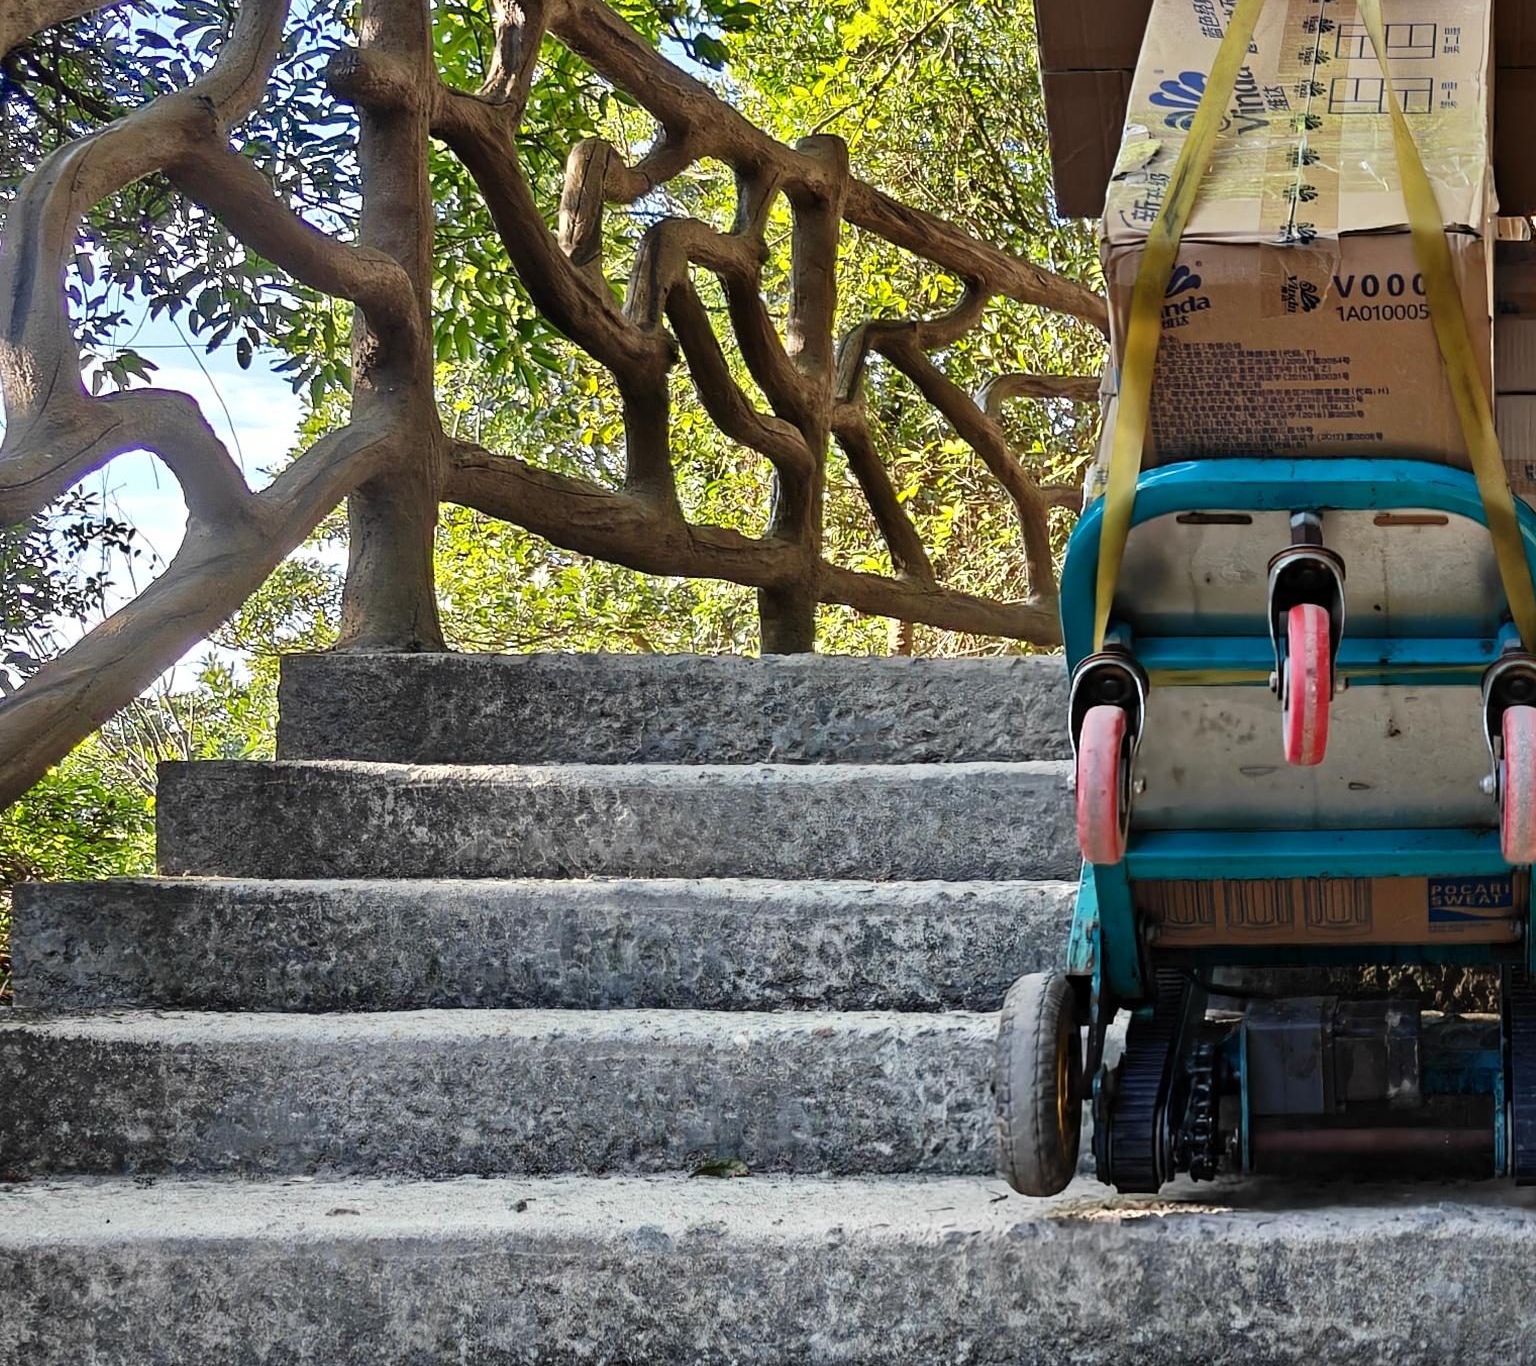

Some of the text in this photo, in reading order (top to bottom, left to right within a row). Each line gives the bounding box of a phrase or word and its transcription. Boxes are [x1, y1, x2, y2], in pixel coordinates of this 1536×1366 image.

[1263, 86, 1291, 111] 维达
[1431, 883, 1510, 894] POCARI
[1431, 894, 1502, 905] SWEAT
